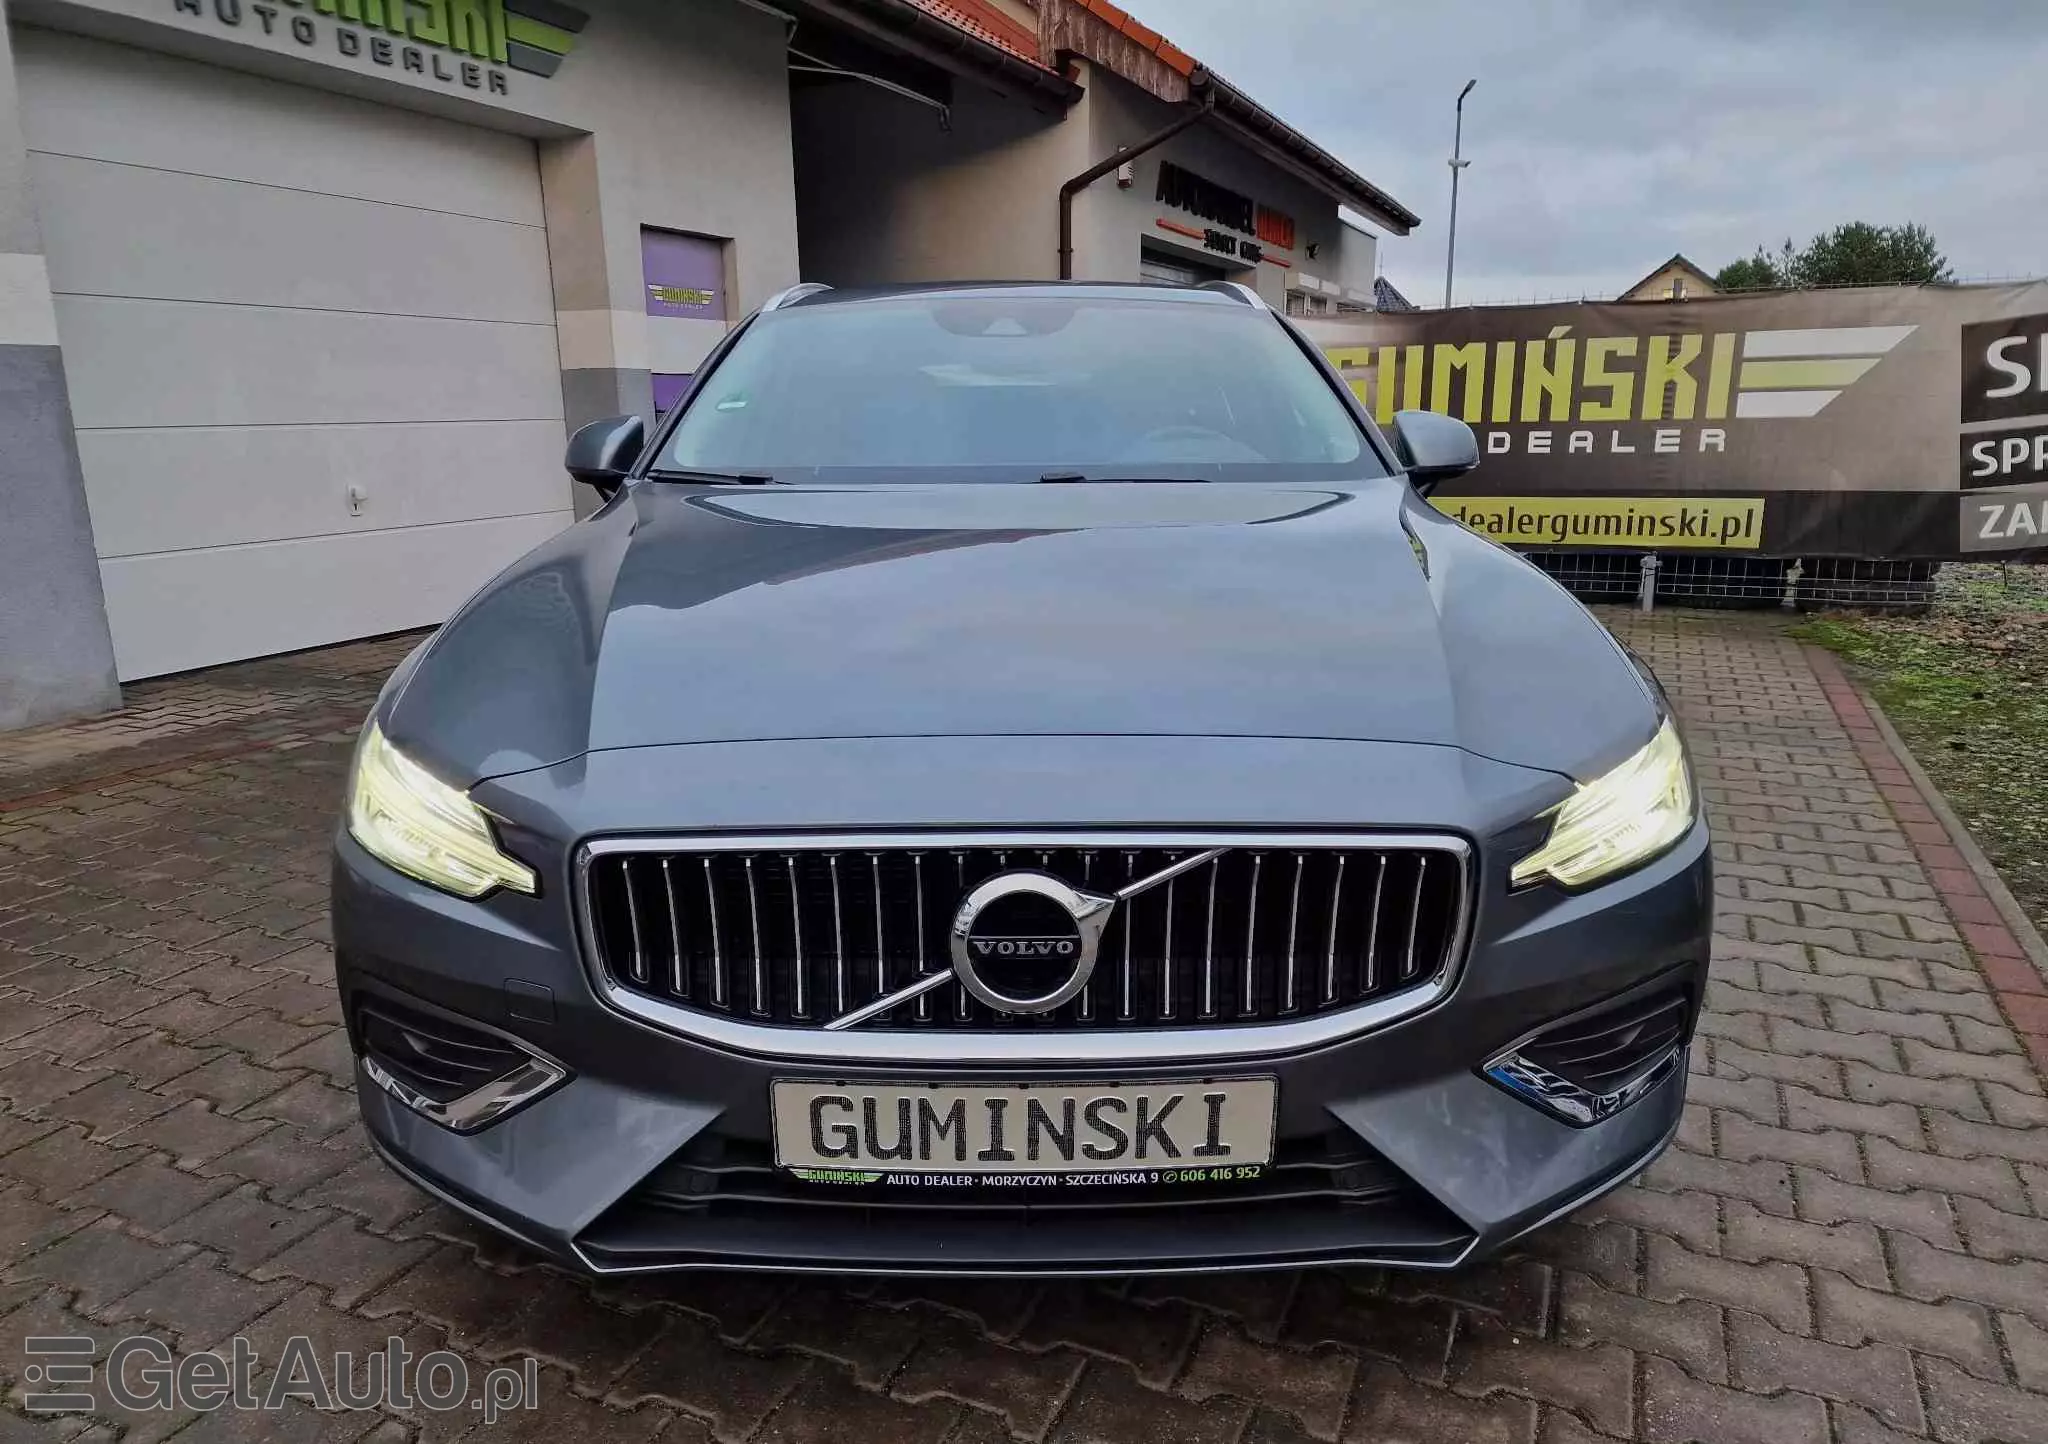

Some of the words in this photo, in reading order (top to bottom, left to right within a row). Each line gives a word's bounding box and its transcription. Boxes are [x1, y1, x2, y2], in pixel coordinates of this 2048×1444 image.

[336, 27, 508, 96] DEALER
[1986, 332, 2048, 398] S
[1487, 428, 1727, 454] DEALER
[1979, 500, 2048, 539] ZA
[973, 941, 1074, 955] VOLVO
[809, 1093, 1231, 1162] GUMINSKI
[886, 1175, 920, 1186] AUTO
[924, 1175, 973, 1187] DEALER
[982, 1175, 1057, 1187] MORZYCZYN
[1065, 1172, 1147, 1185] SZCZECIŃSKA
[1150, 1172, 1159, 1183] 9
[1180, 1170, 1206, 1182] 606
[1210, 1169, 1232, 1181] 416
[1235, 1166, 1261, 1179] 952
